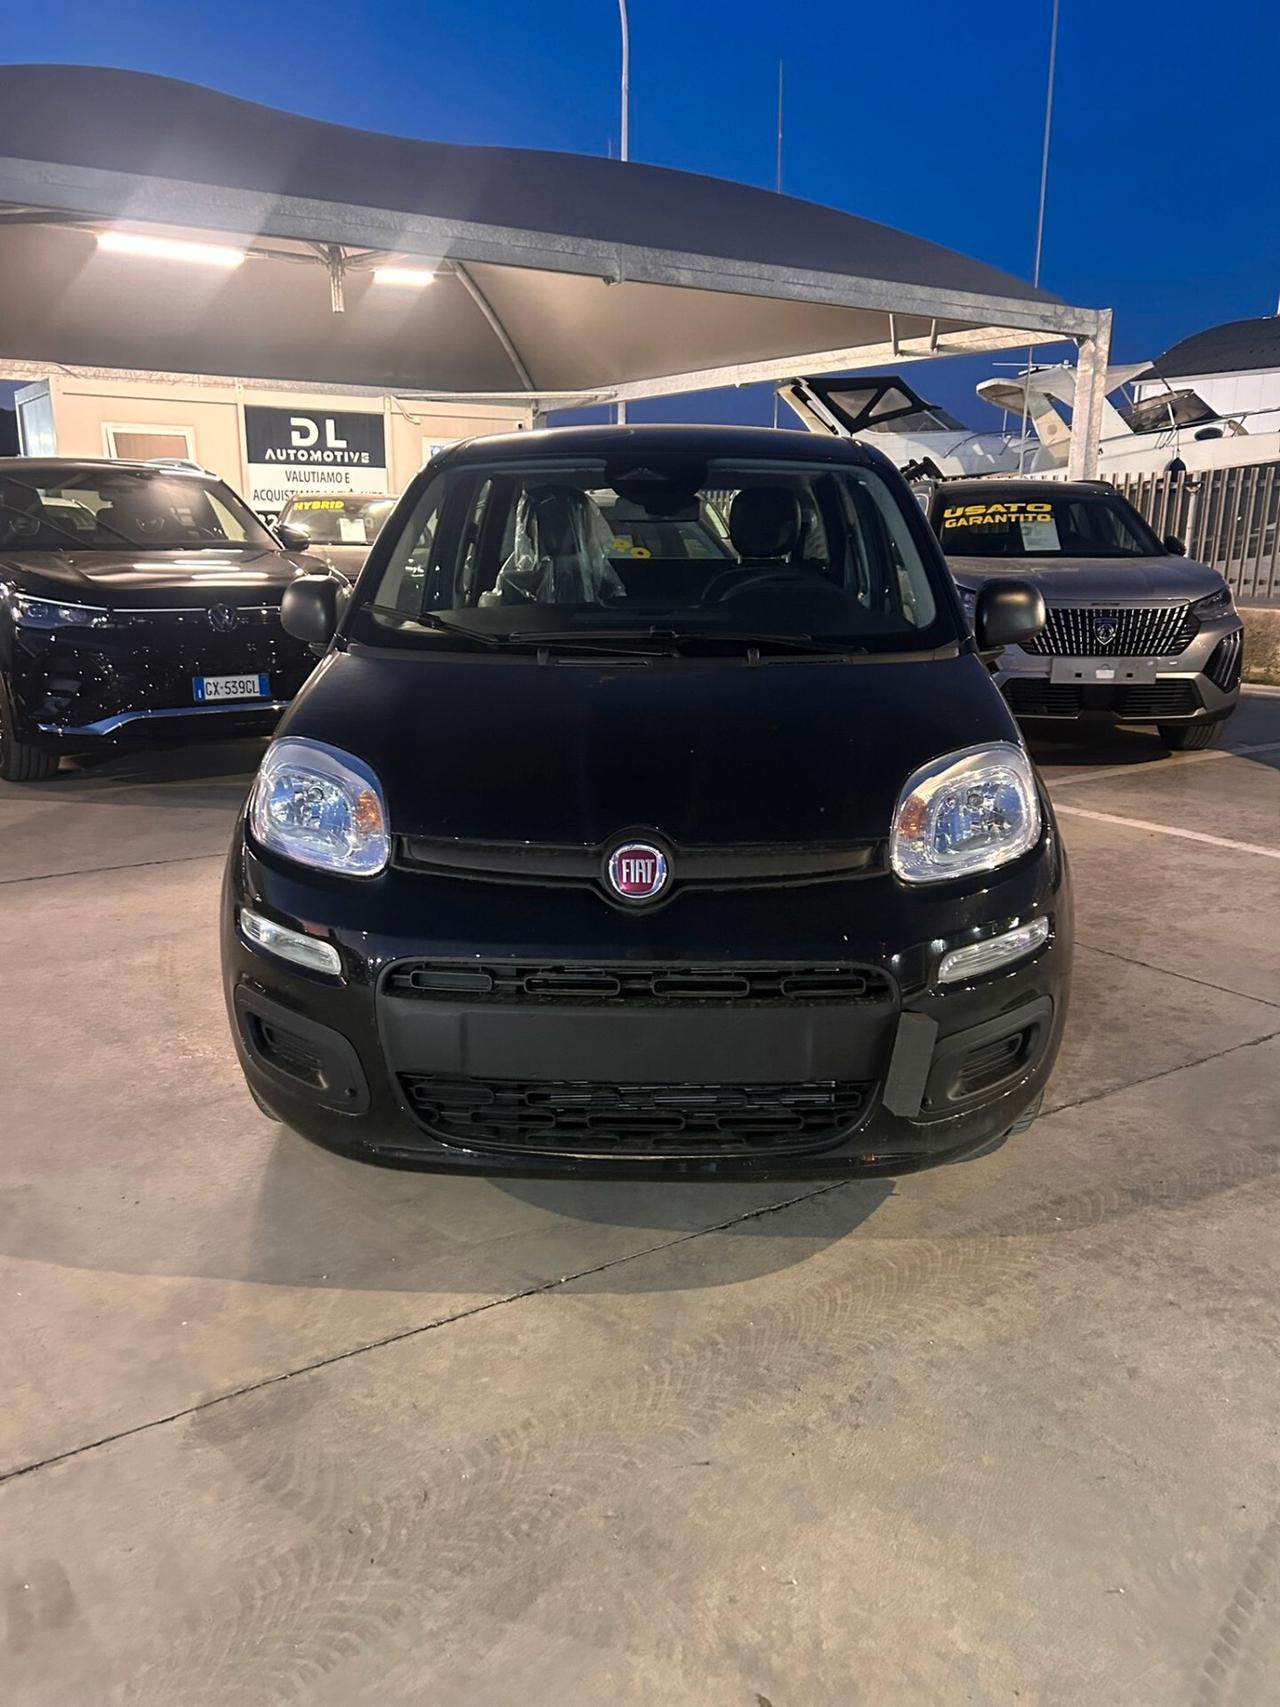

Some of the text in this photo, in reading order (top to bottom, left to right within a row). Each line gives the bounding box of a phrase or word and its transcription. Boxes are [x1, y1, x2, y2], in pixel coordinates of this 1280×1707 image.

[290, 417, 347, 448] DL
[265, 448, 370, 464] AUTOMOTIVE
[285, 470, 350, 484] VALUTIAMO E
[293, 500, 345, 511] HYBRID
[943, 503, 1052, 518] USATO
[945, 513, 1051, 528] GARANTITO
[622, 859, 655, 883] FIAT
